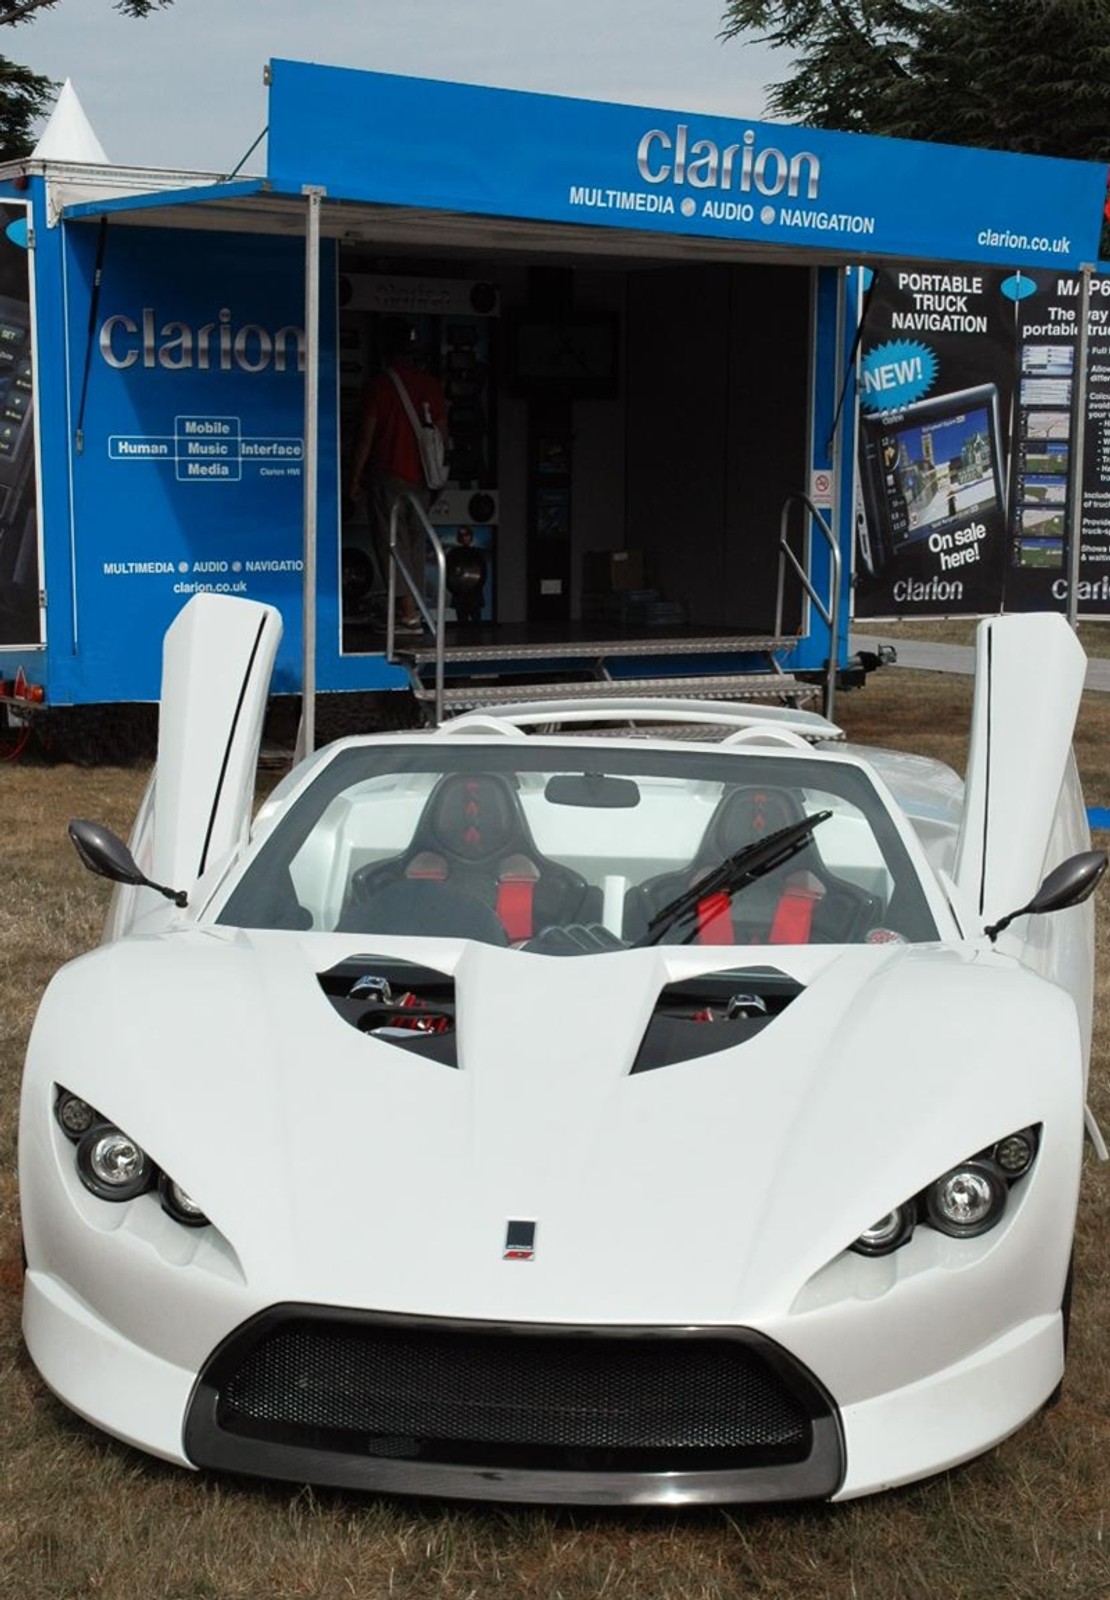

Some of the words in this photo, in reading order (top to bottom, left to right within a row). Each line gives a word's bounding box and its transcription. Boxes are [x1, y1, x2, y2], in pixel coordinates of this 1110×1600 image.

[569, 187, 675, 214] MULTIMEDIA
[702, 201, 754, 223] AUDIO
[779, 208, 875, 234] NAVIGATION
[978, 229, 1070, 254] clarion.co.uk
[899, 273, 983, 294] PORTABLE
[913, 294, 968, 313] TRUCK
[891, 312, 988, 333] NAVIGATION
[1047, 307, 1076, 321] The
[1087, 310, 1109, 324] ay
[1087, 323, 1110, 336] tru
[864, 356, 923, 394] NEW!
[185, 421, 231, 434] Mobile
[118, 441, 168, 454] Human
[187, 442, 229, 455] Music
[241, 443, 301, 456] Interface
[187, 463, 230, 475] Media
[928, 533, 954, 553] On
[954, 522, 987, 546] sale
[940, 545, 981, 571] here!
[103, 562, 175, 574] MULTIMEDIA
[192, 561, 229, 573] AUDIO
[245, 560, 304, 572] NAVIGATIO
[173, 580, 247, 593] clarion.co.uk
